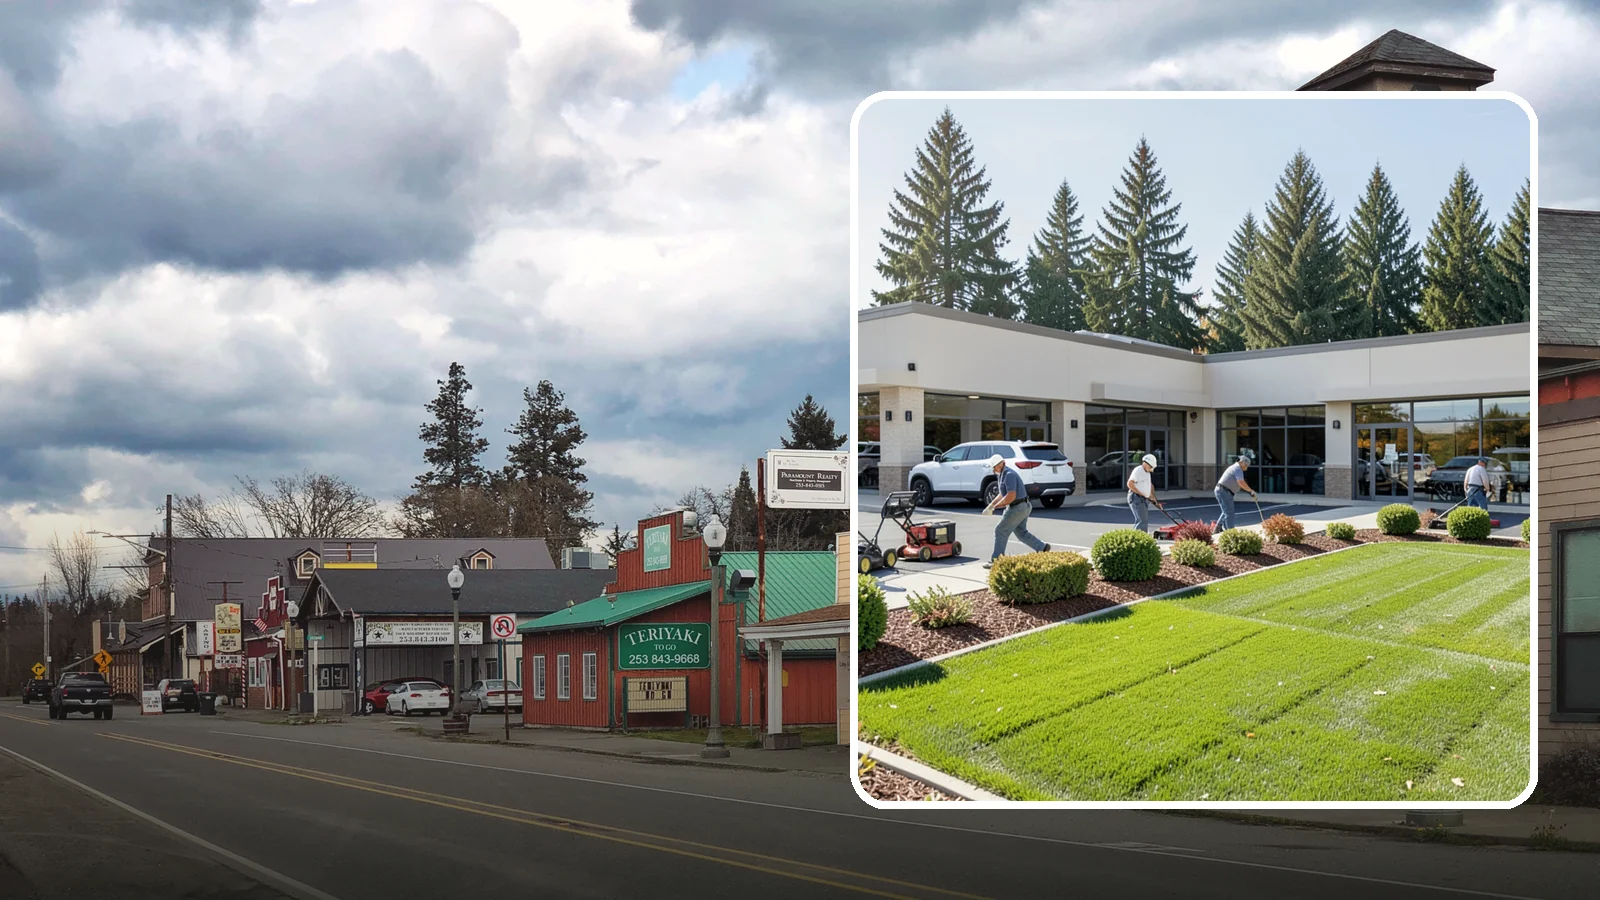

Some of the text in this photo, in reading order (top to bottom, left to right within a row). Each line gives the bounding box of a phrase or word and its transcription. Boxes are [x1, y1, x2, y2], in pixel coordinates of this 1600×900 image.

[624, 627, 702, 646] TERIYAKI
[653, 643, 676, 651] TO GO
[628, 653, 700, 665] 253 843-9668
